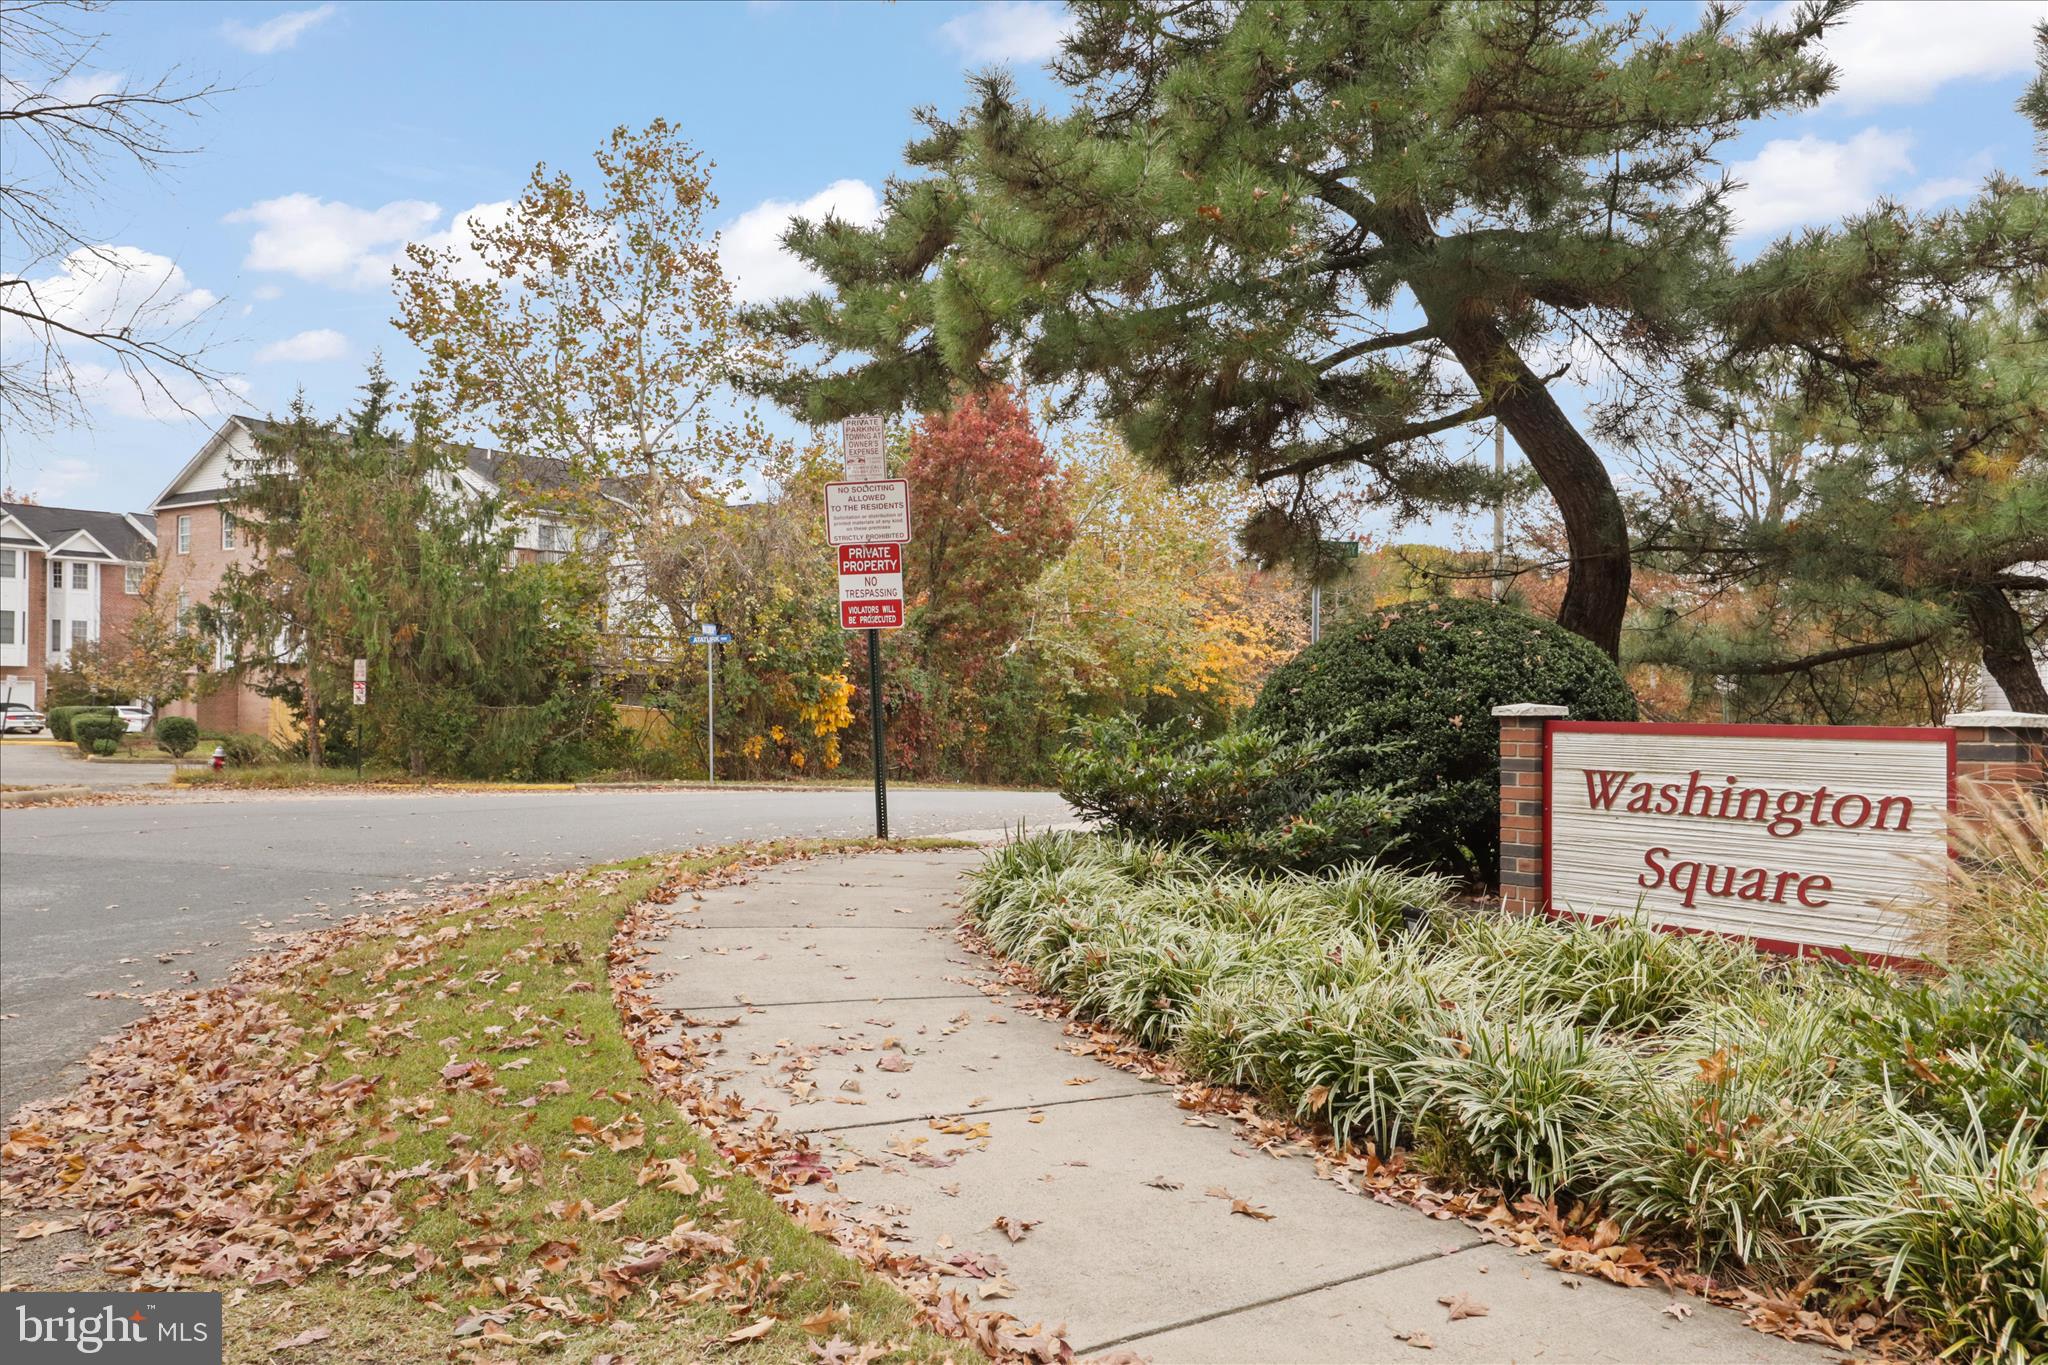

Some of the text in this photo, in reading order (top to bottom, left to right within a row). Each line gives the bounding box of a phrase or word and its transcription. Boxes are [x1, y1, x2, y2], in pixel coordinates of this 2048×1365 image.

[852, 484, 894, 493] SOLICITING
[860, 502, 904, 510] RESIDENTS
[848, 547, 891, 559] PRIVATE
[843, 560, 897, 572] PROPERTY
[864, 576, 877, 586] NO
[846, 588, 897, 598] TRESPASSING
[848, 605, 879, 614] VIOLATORS
[848, 615, 896, 624] BE PROSECUTED
[1582, 769, 1914, 838] Washington
[1638, 847, 1833, 908] Square
